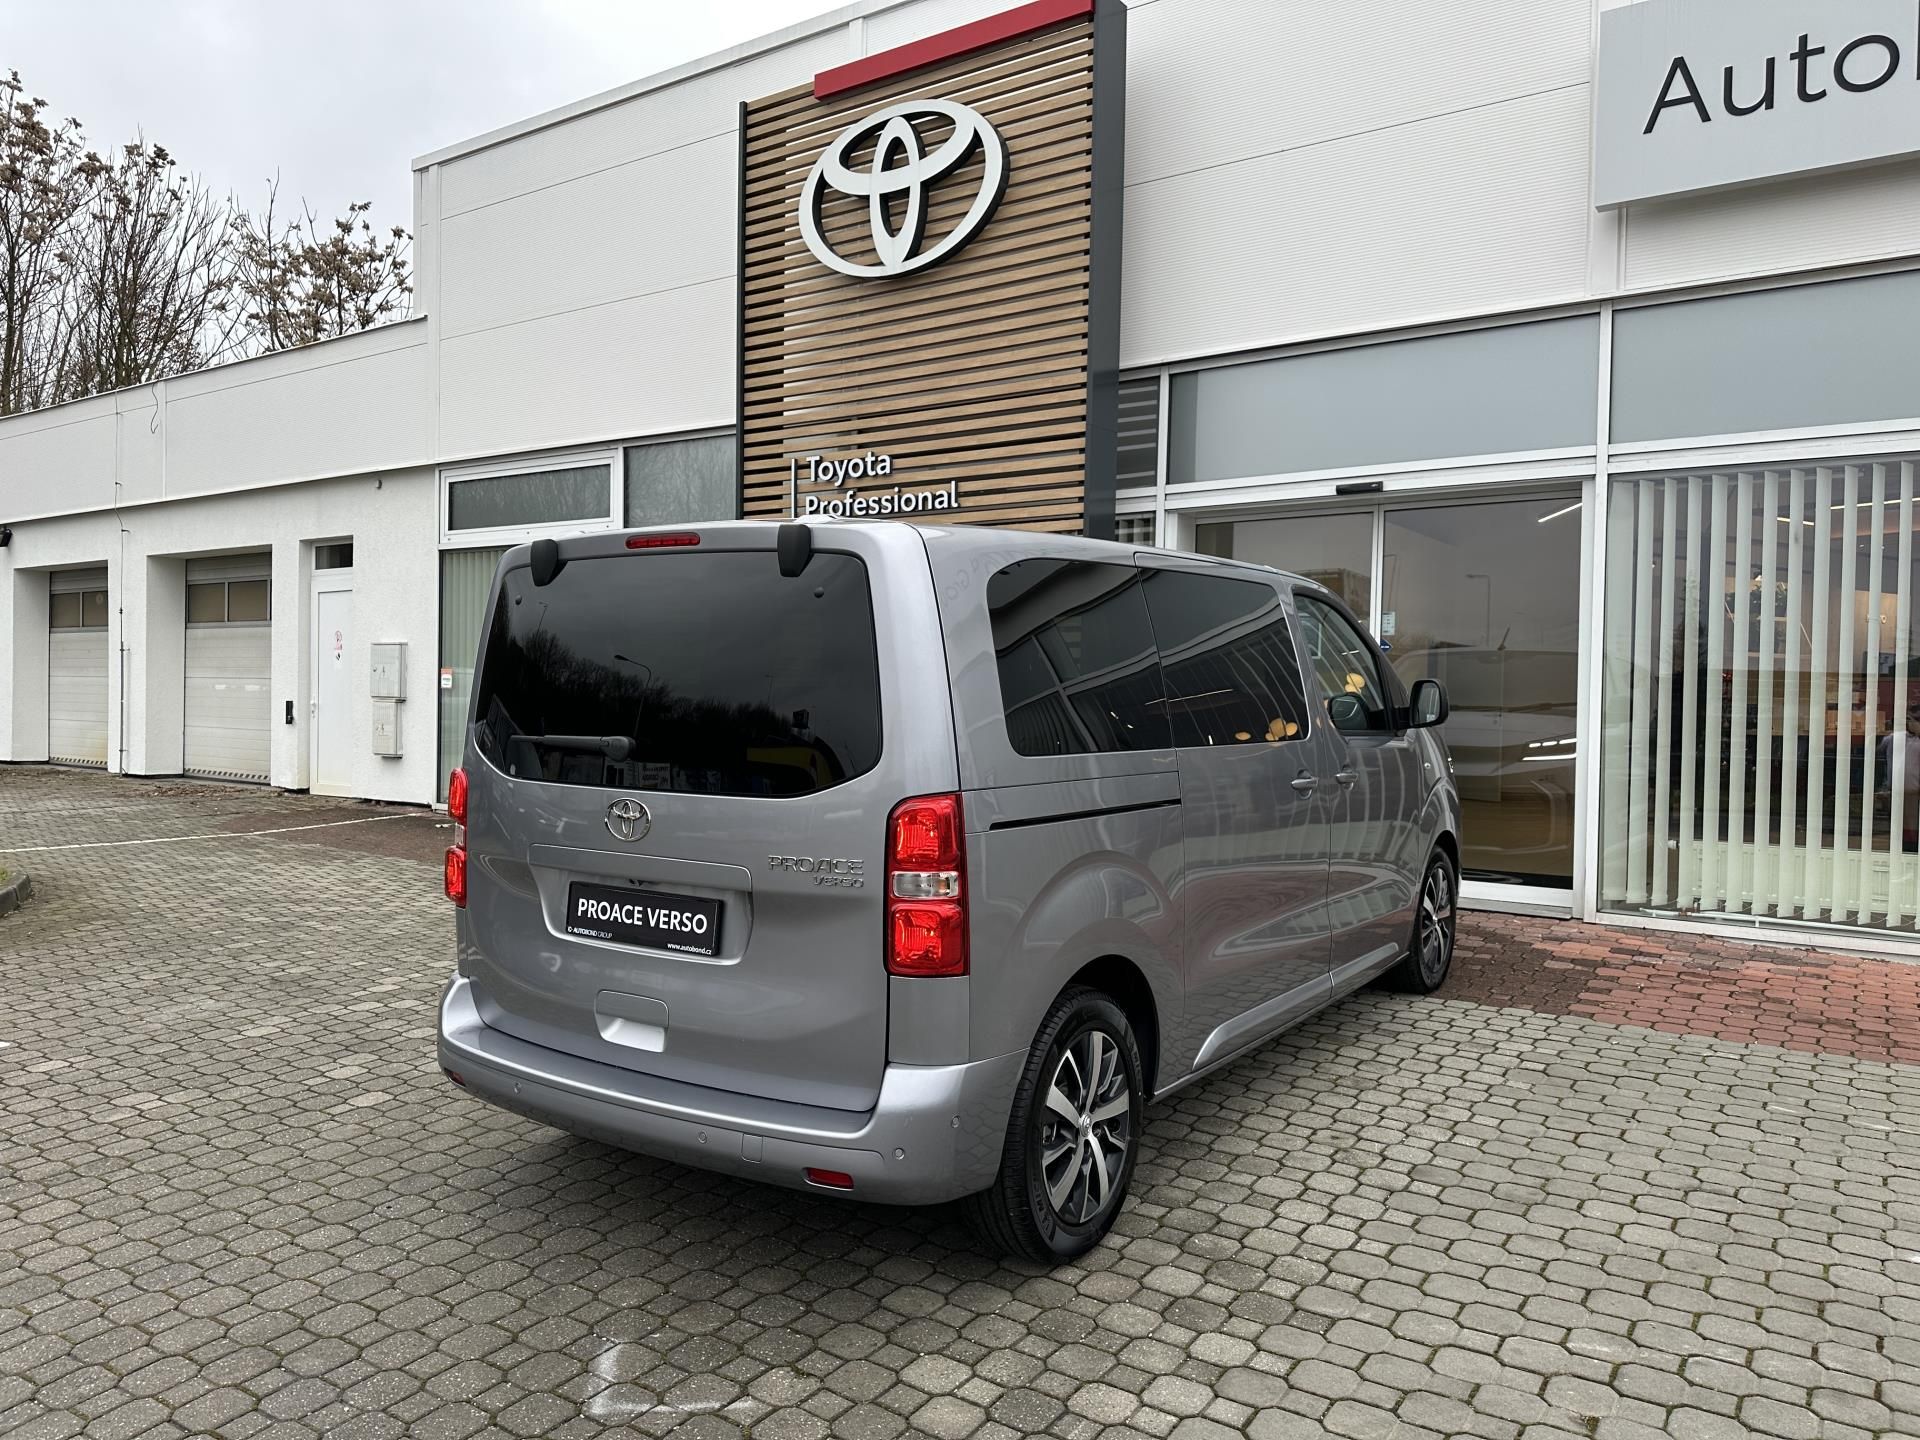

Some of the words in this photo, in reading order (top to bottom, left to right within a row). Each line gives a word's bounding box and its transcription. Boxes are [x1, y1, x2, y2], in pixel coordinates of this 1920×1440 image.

[1643, 0, 1920, 135] Auto
[806, 451, 892, 487] Toyota
[805, 480, 959, 517] Professional
[768, 854, 865, 876] PROACE
[812, 876, 865, 889] VERSO
[577, 898, 643, 926] PROACE
[646, 907, 708, 934] VERSO
[667, 943, 712, 956] www.autobond.cz
